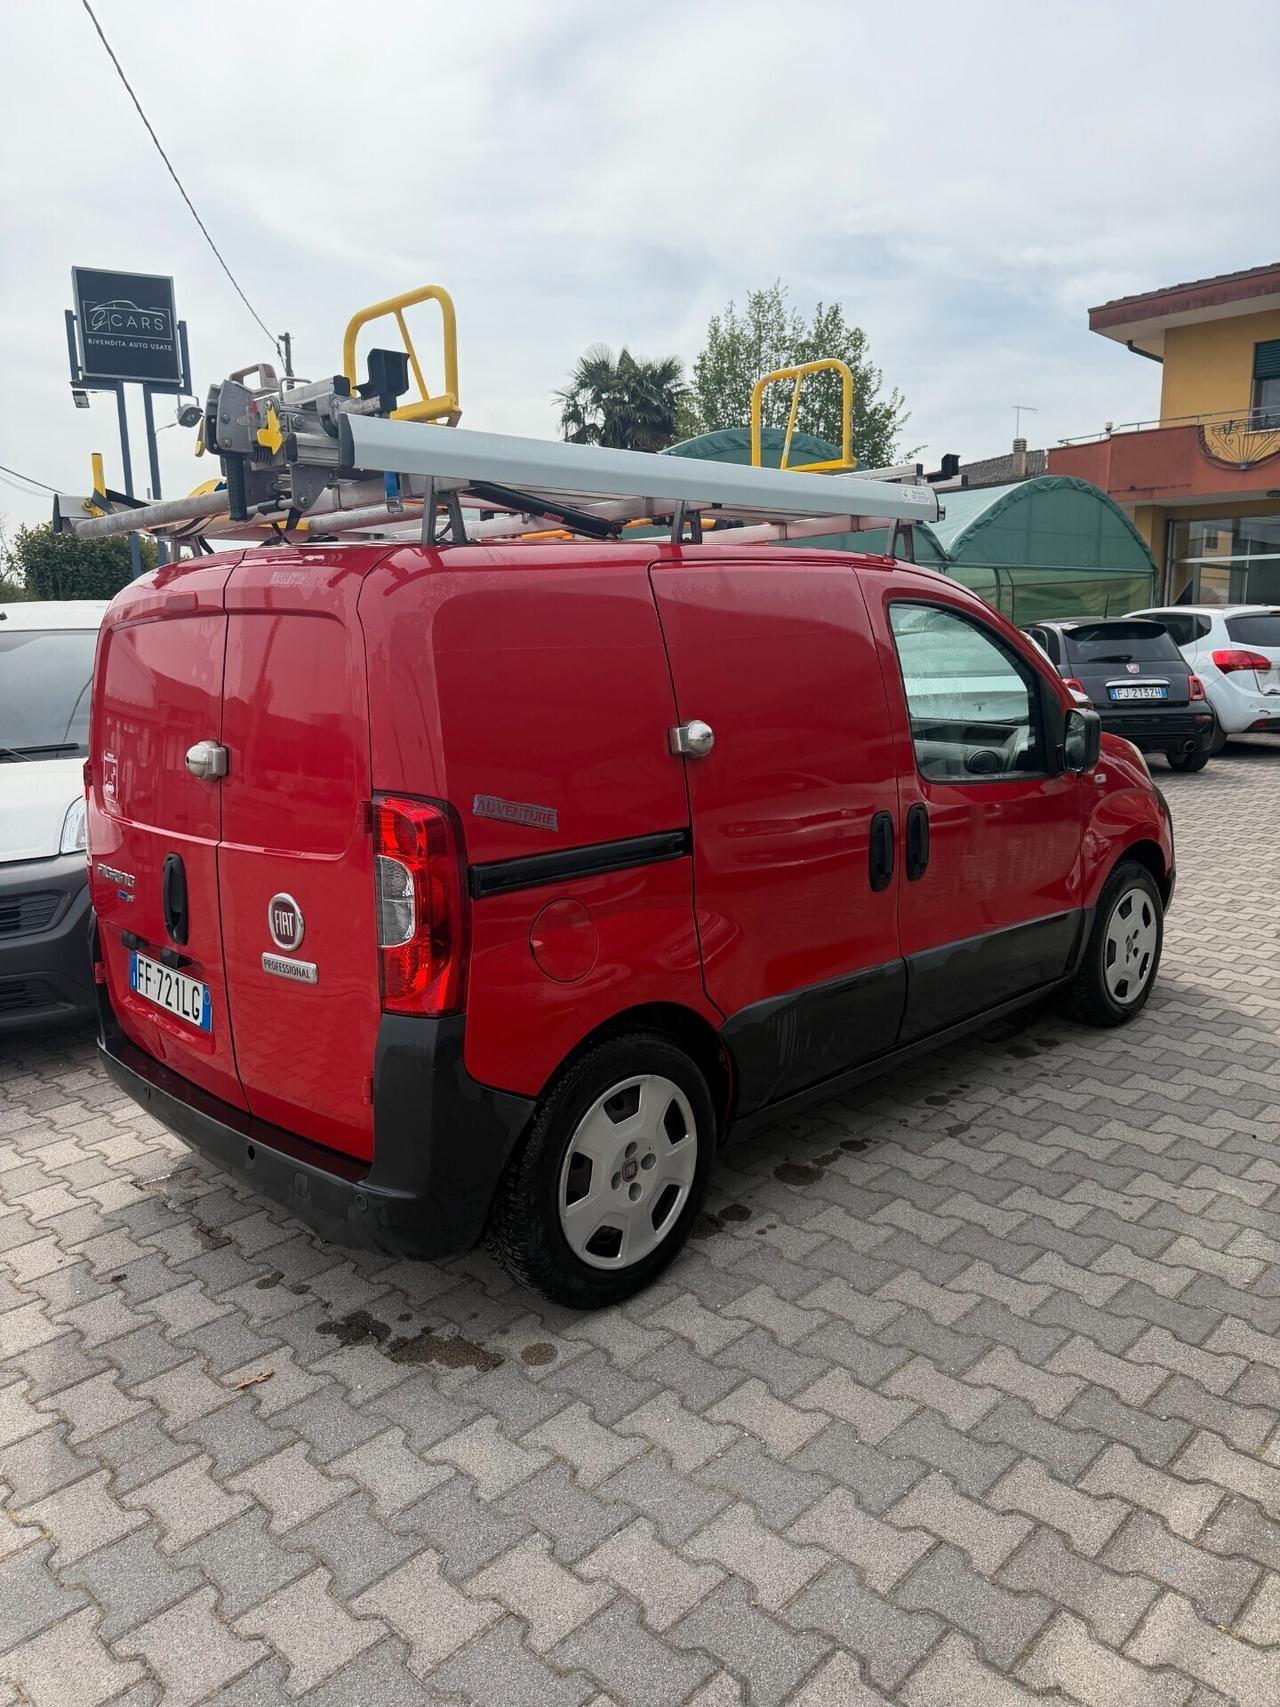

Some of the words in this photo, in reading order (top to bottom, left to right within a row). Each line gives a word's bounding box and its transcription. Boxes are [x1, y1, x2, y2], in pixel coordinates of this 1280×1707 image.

[110, 314, 165, 331] CARS
[87, 338, 127, 347] RIVENDITA
[128, 341, 149, 349] AUTO
[150, 343, 173, 351] USATE
[274, 909, 294, 937] FIAT
[263, 958, 311, 979] PROFESSIONAL
